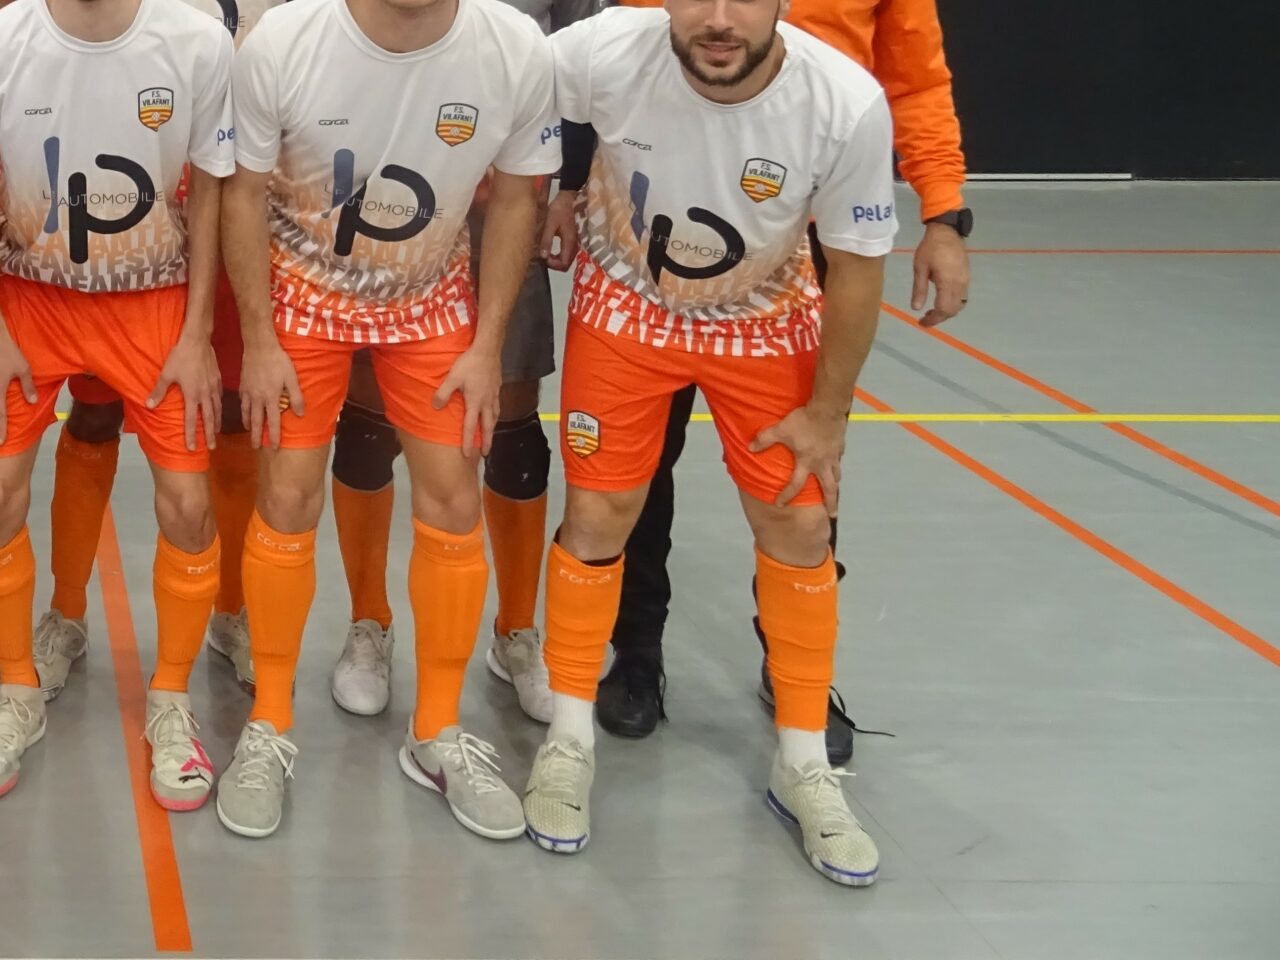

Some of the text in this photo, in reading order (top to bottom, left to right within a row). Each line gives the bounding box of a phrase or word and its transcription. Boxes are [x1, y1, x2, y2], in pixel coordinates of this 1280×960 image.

[142, 98, 170, 107] VILAFANT
[442, 112, 473, 123] VILAFANT
[749, 168, 780, 181] VILAFANT
[58, 190, 165, 208] AUTOMOBILE
[345, 199, 445, 220] UTOMOBILE
[852, 202, 893, 223] pela
[652, 232, 753, 262] UTOMOBILE
